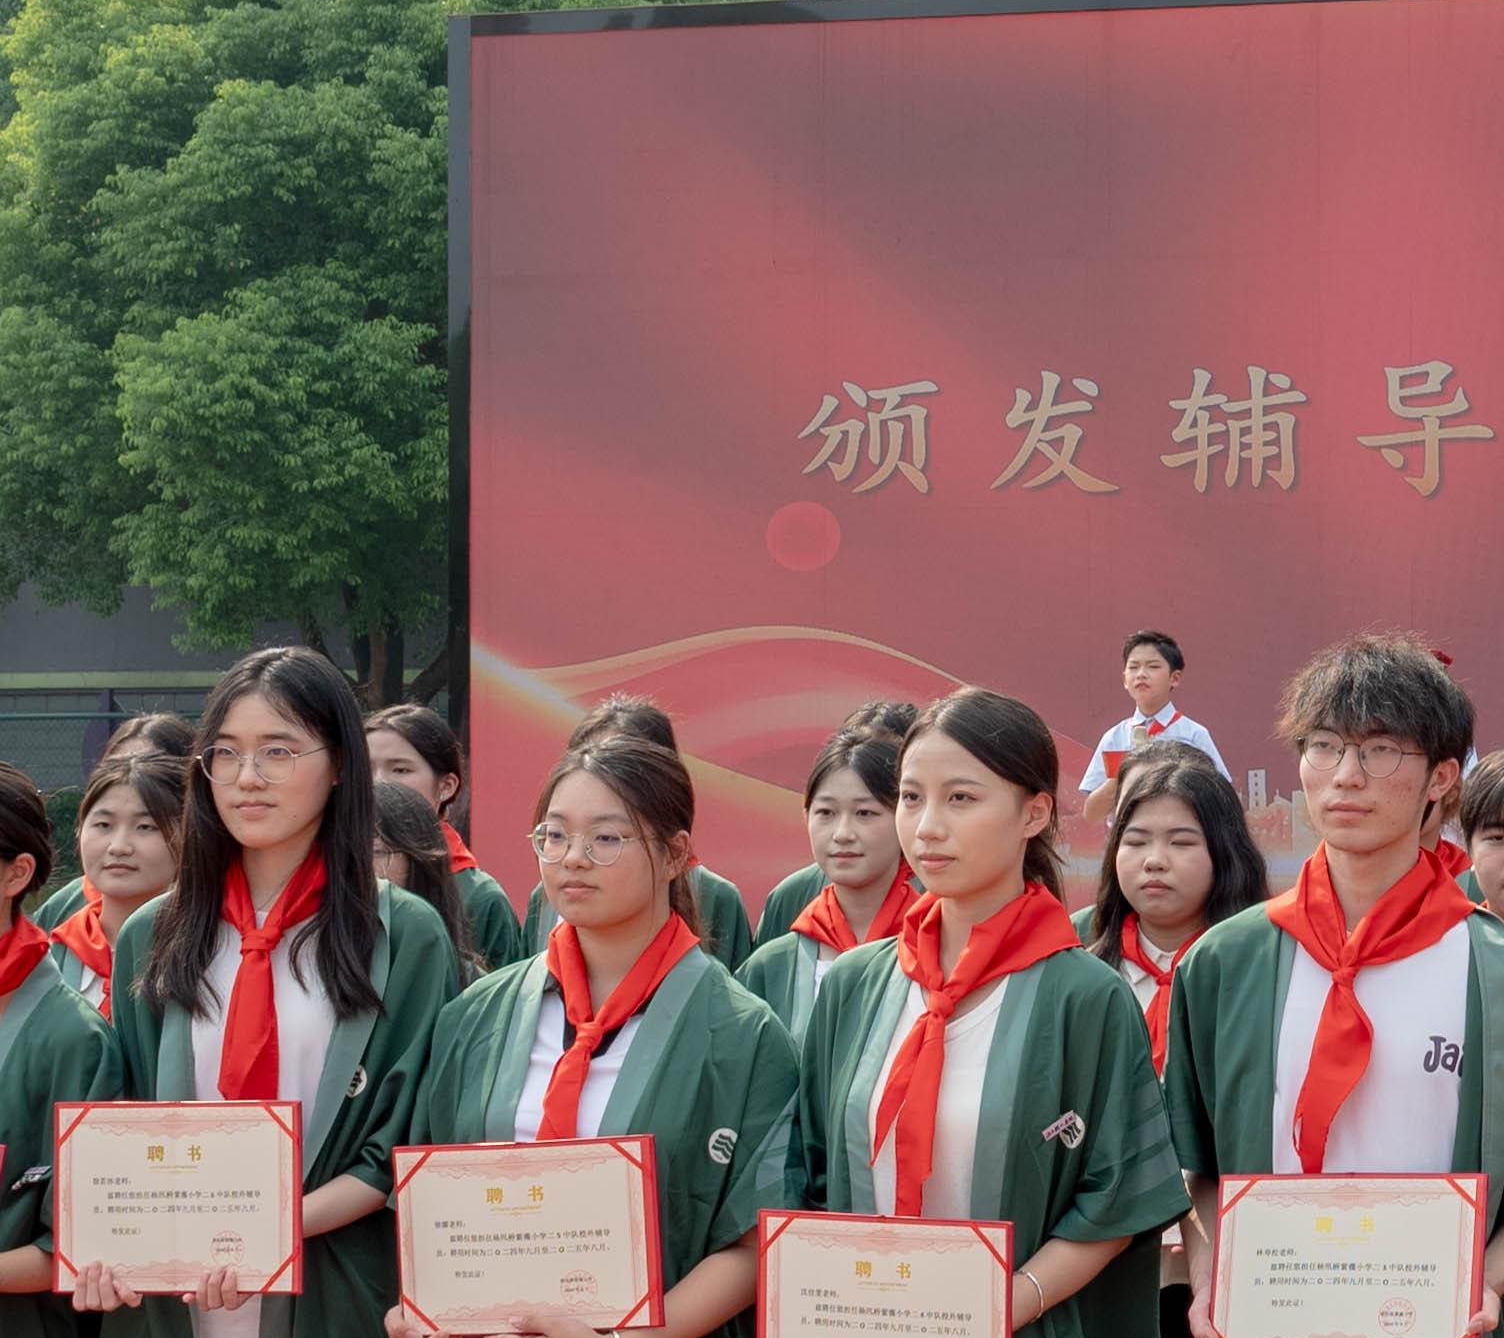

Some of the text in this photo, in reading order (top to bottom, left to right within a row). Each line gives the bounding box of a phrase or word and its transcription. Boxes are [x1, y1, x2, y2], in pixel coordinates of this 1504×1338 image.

[1423, 1035, 1464, 1077] Ja
[146, 1145, 202, 1162] 聘书
[485, 1184, 545, 1204] 聘书
[855, 1260, 912, 1279] 聘书
